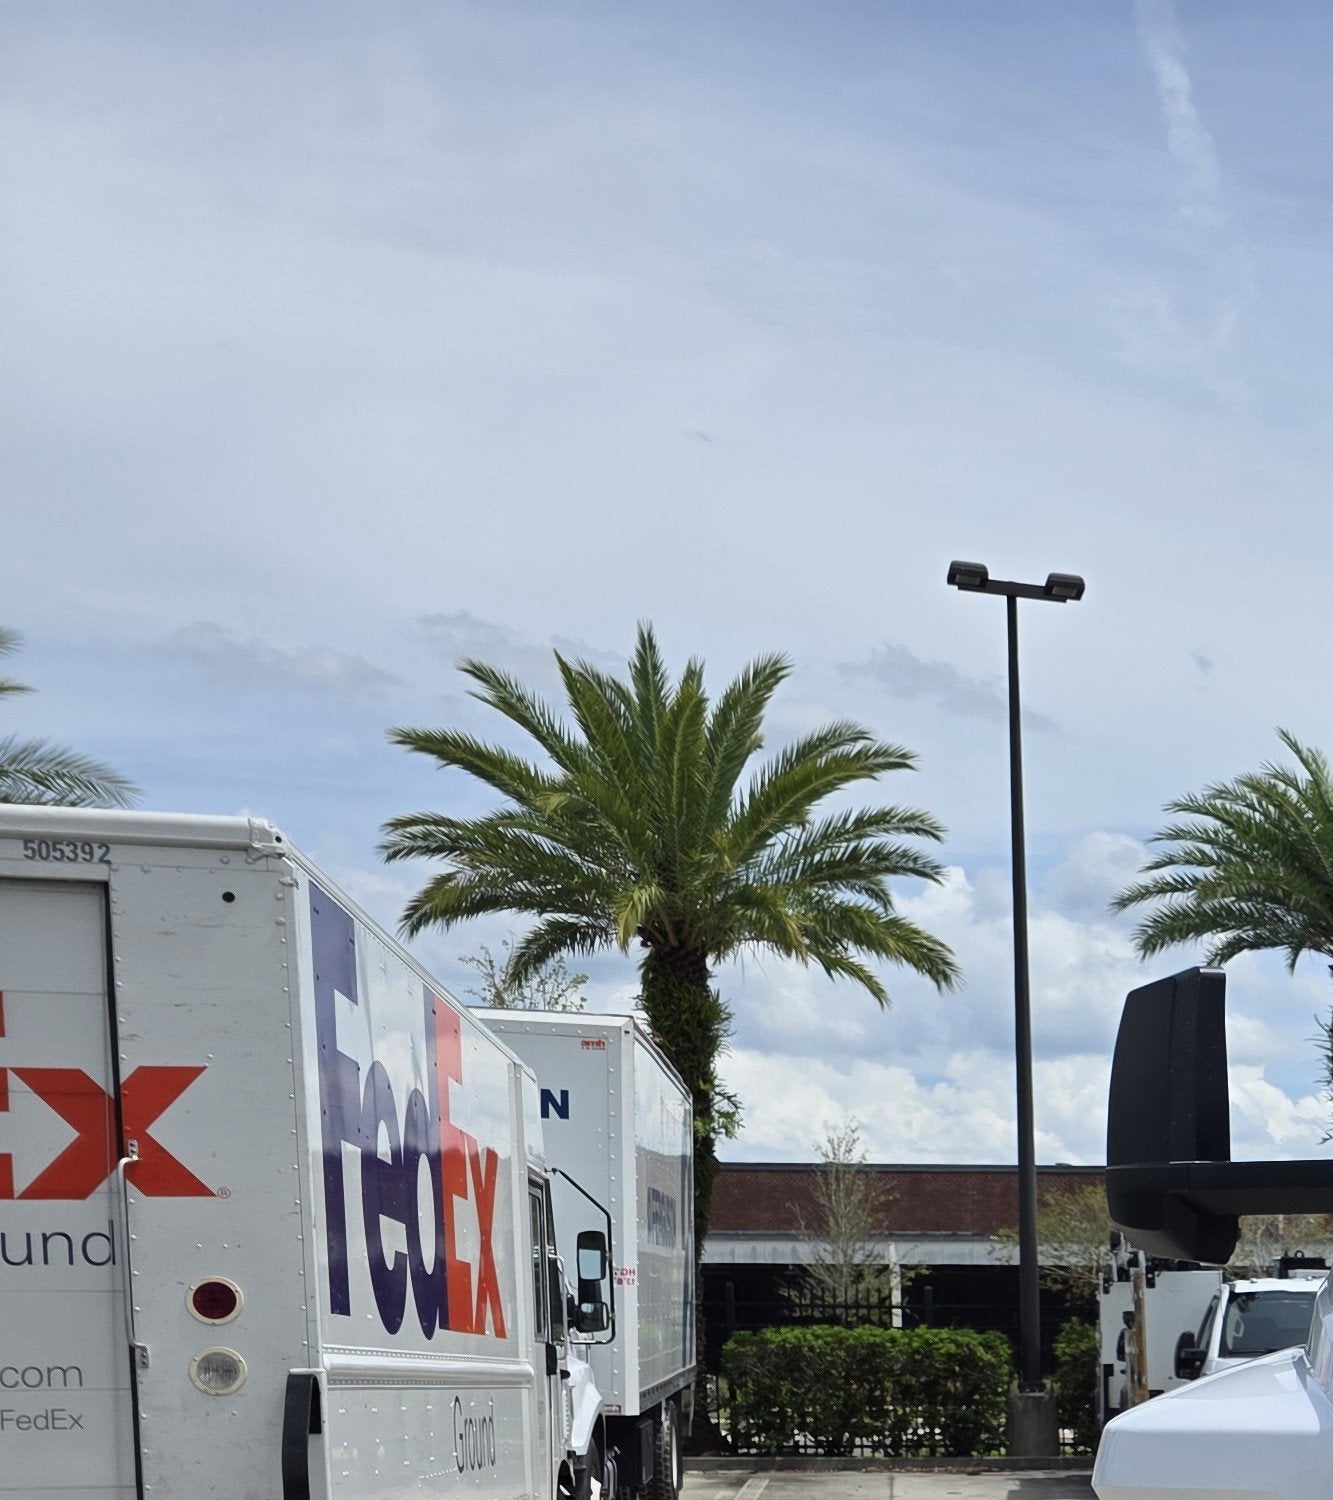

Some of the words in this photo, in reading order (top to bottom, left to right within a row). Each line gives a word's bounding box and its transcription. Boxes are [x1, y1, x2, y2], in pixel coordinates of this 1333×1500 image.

[22, 837, 112, 864] 505392
[308, 880, 507, 1340] FedEx
[0, 1219, 116, 1266] und
[0, 1408, 84, 1431] FedEx
[453, 1395, 496, 1474] Ground
